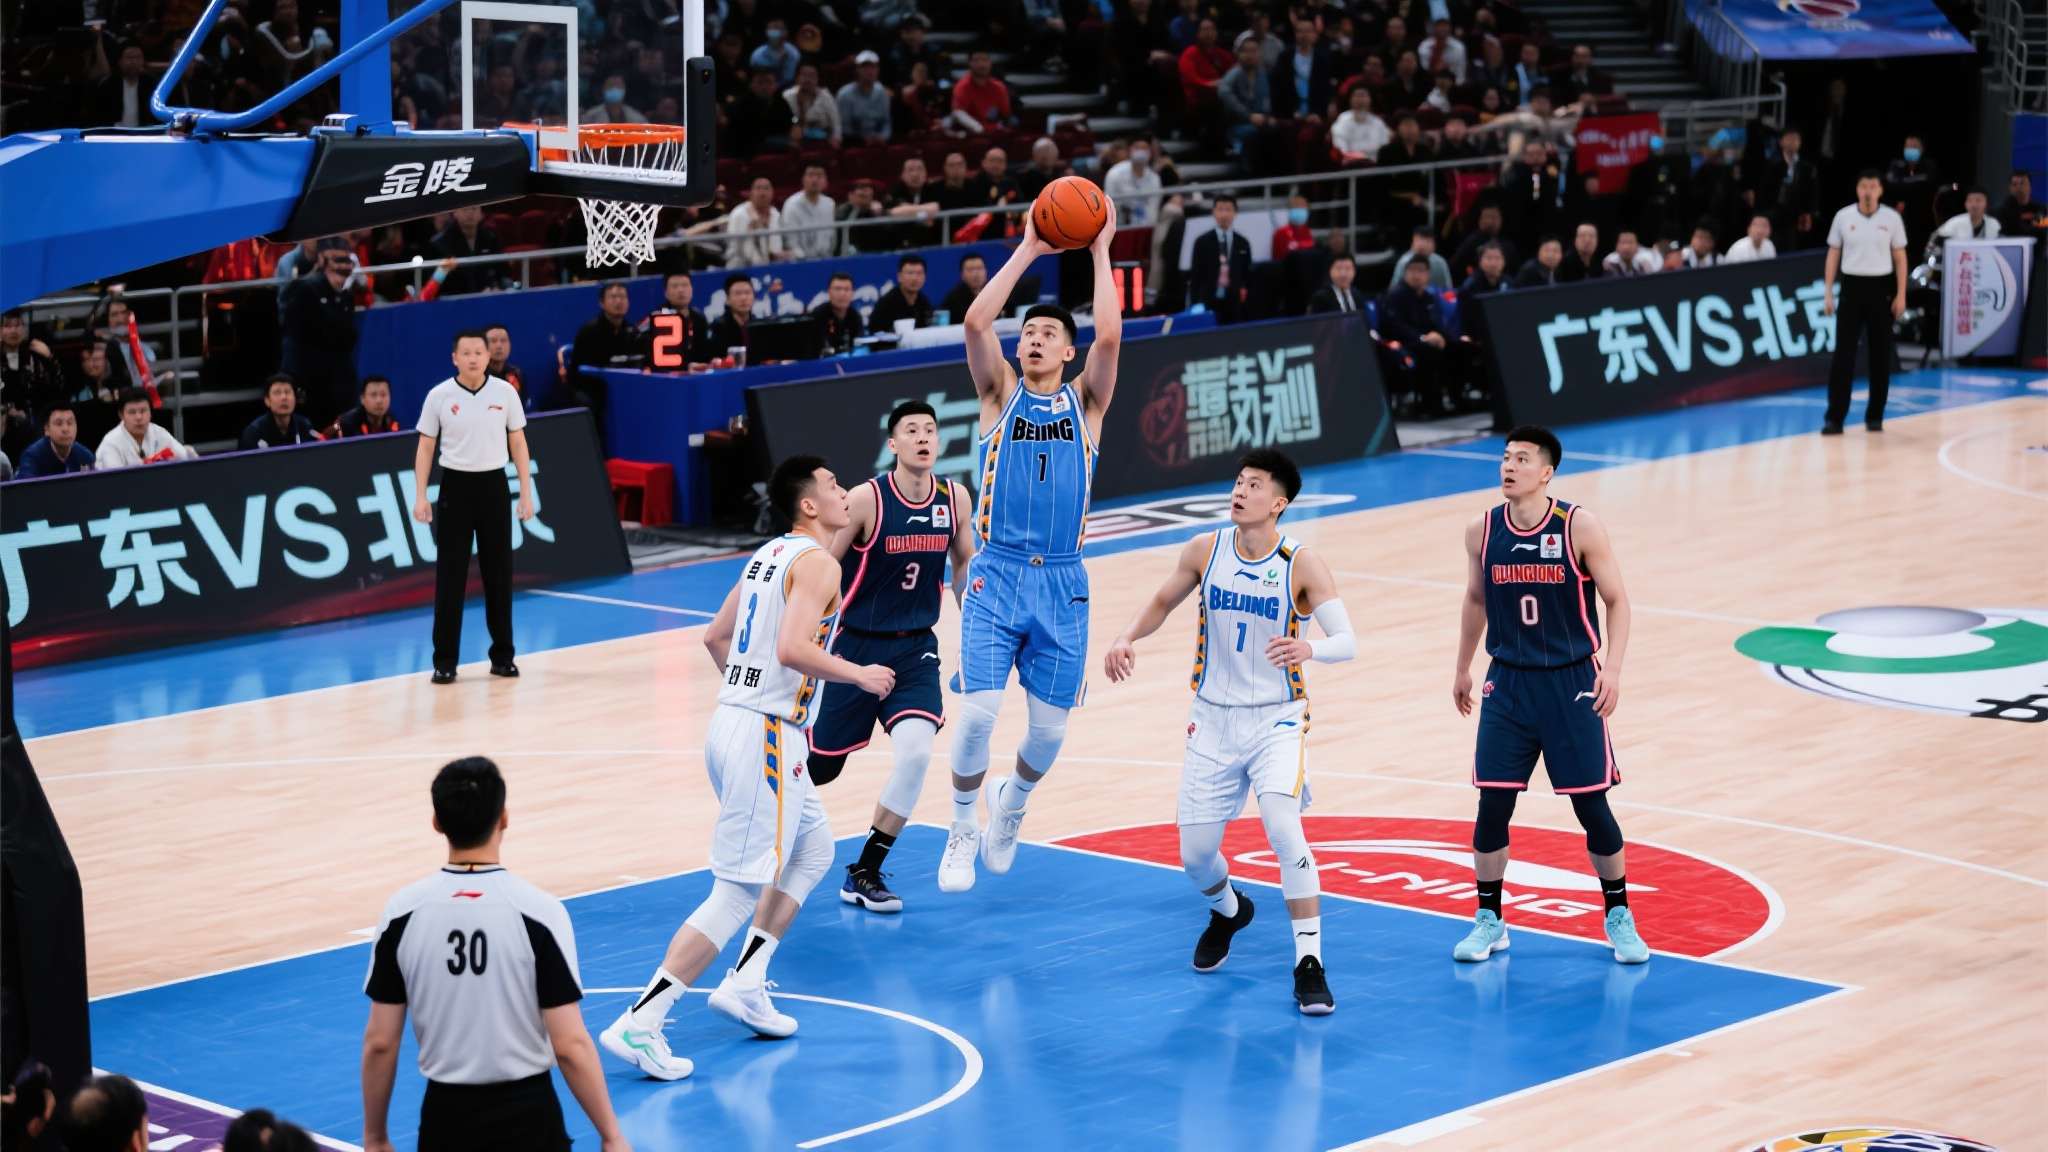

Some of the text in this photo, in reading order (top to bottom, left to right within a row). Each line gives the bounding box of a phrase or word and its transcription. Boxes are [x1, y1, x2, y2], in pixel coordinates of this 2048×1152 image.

[364, 157, 487, 204] 金陵
[653, 315, 683, 367] 2
[901, 562, 920, 590] 3
[738, 592, 759, 654] 3
[1520, 594, 1539, 626] 0
[1236, 622, 1248, 653] 1
[446, 928, 488, 976] 30
